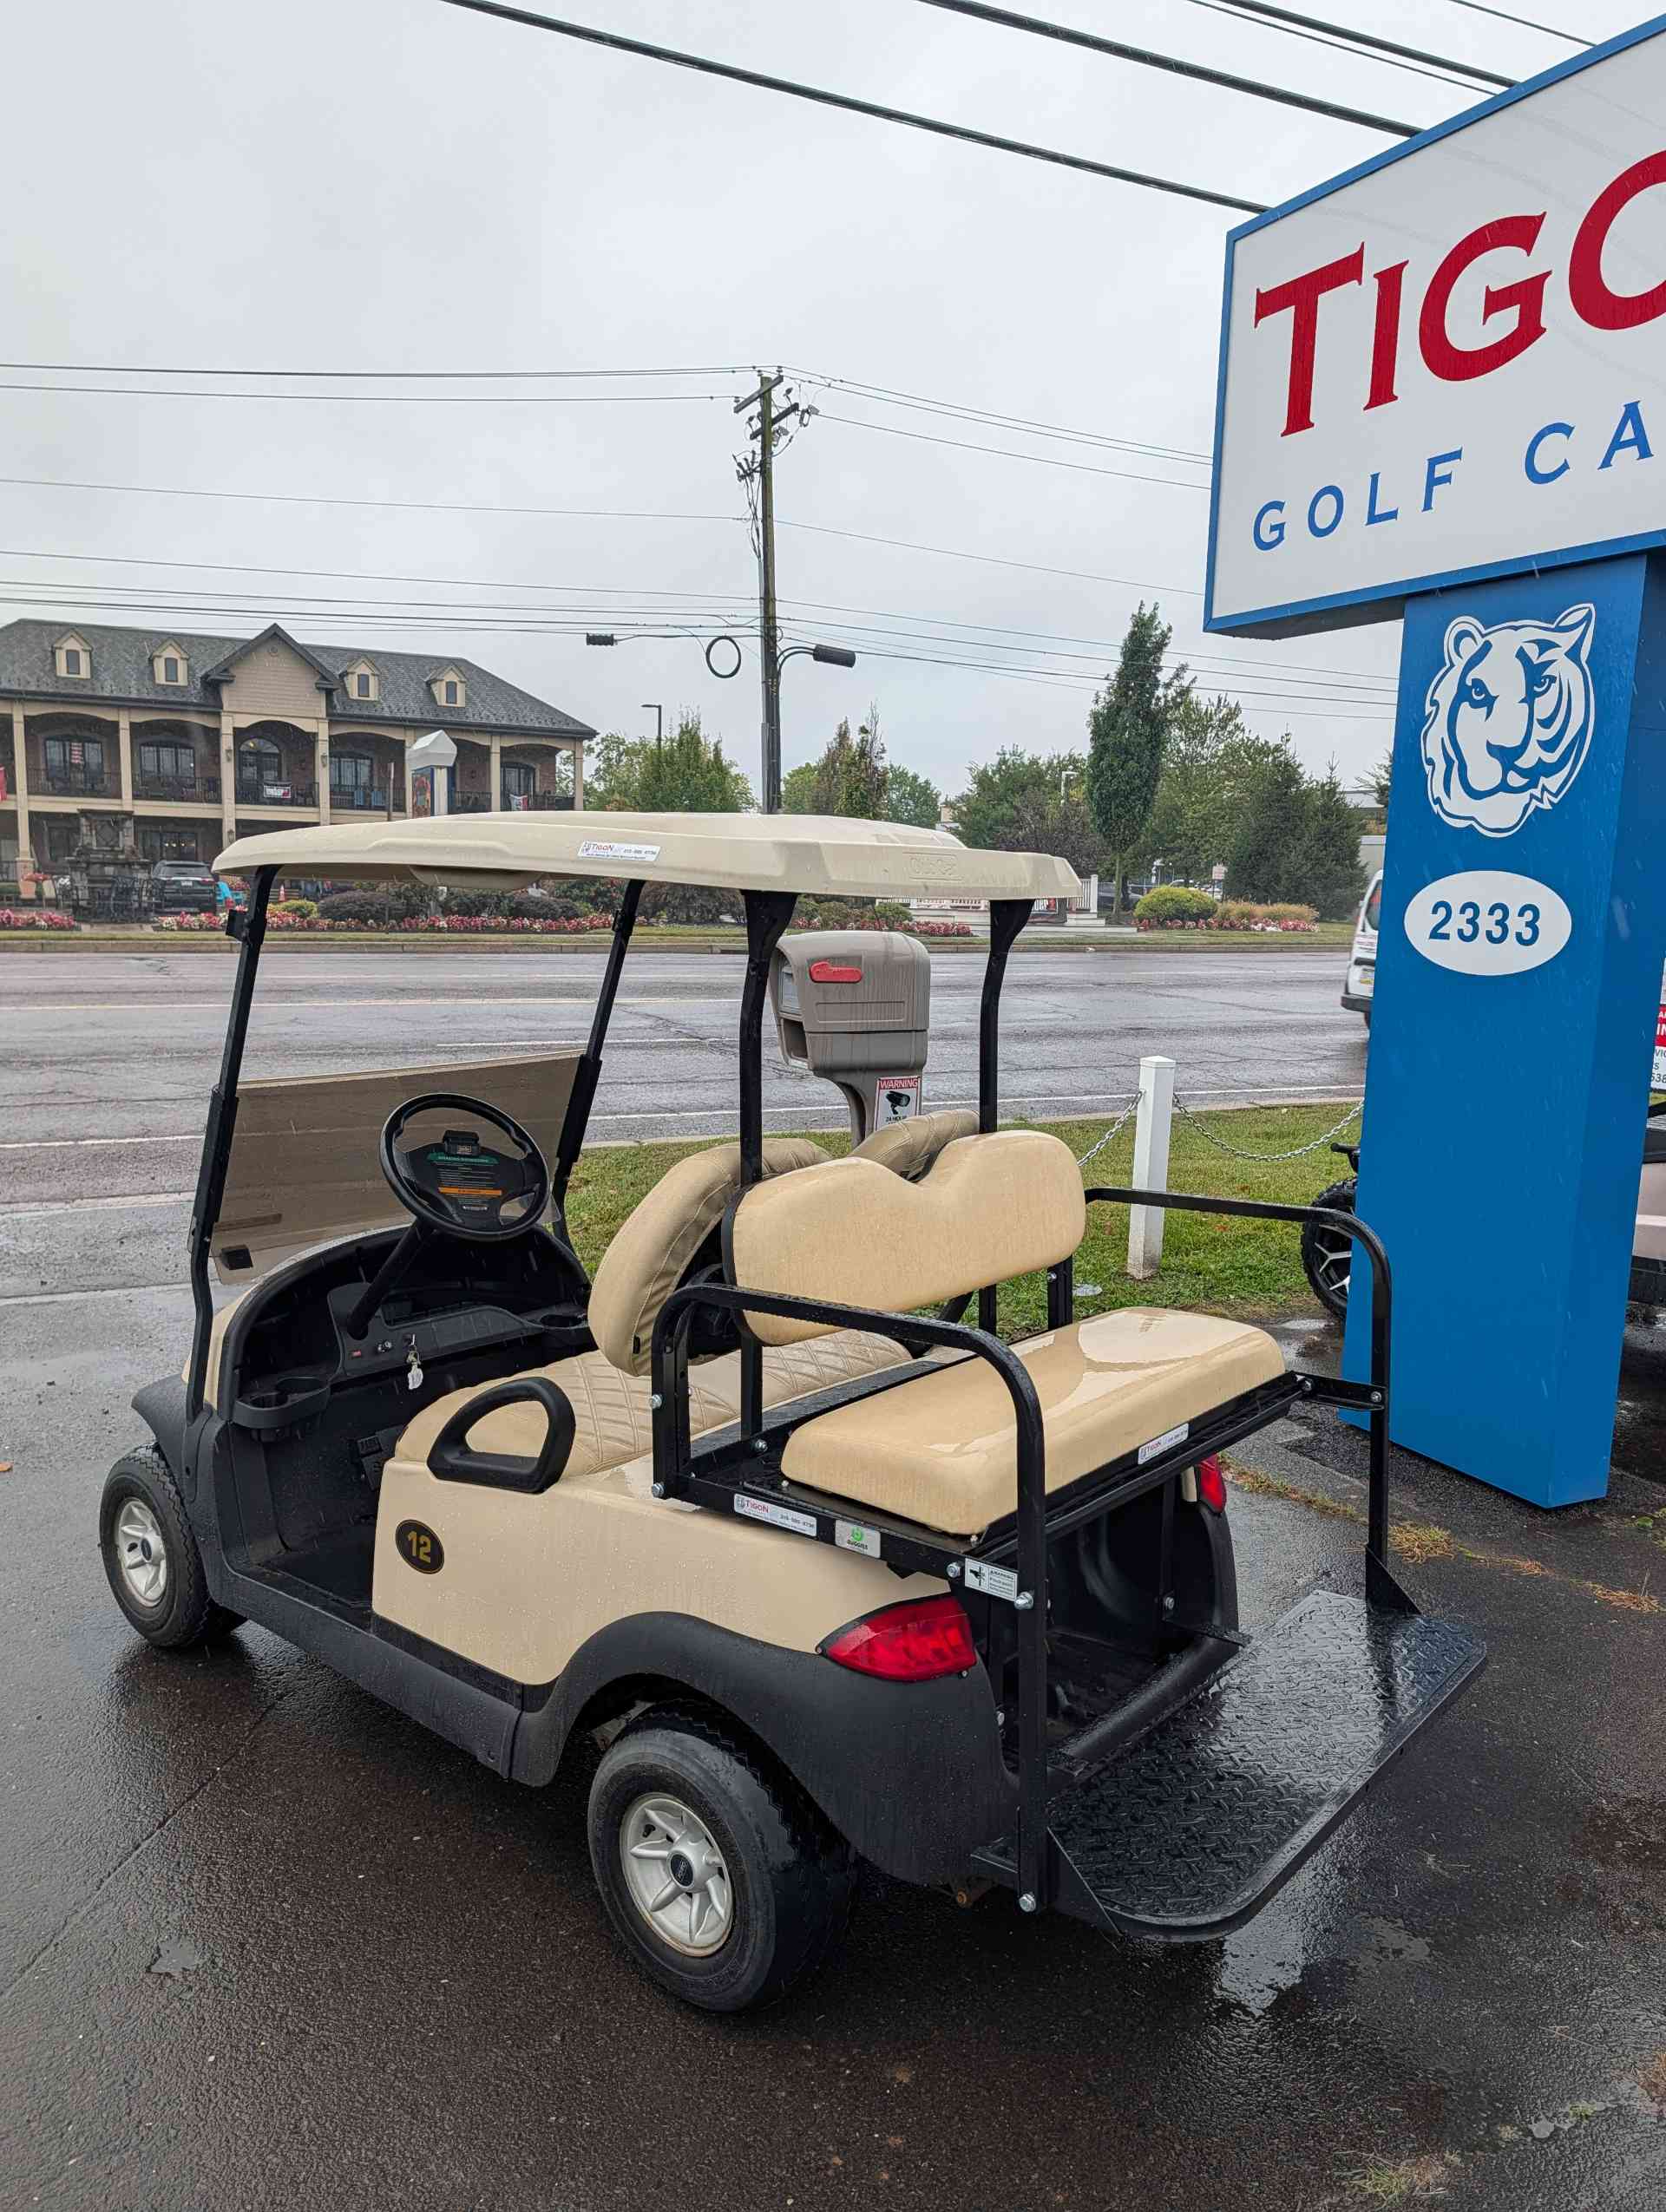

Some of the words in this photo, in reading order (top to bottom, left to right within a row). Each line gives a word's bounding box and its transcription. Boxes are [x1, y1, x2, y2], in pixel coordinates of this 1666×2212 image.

[1254, 450, 1462, 551] GOLF
[1525, 402, 1651, 484] CA
[1430, 901, 1539, 945] 2333
[880, 1078, 918, 1090] WARNING
[745, 1499, 770, 1514] TIGON
[408, 1530, 432, 1564] 12
